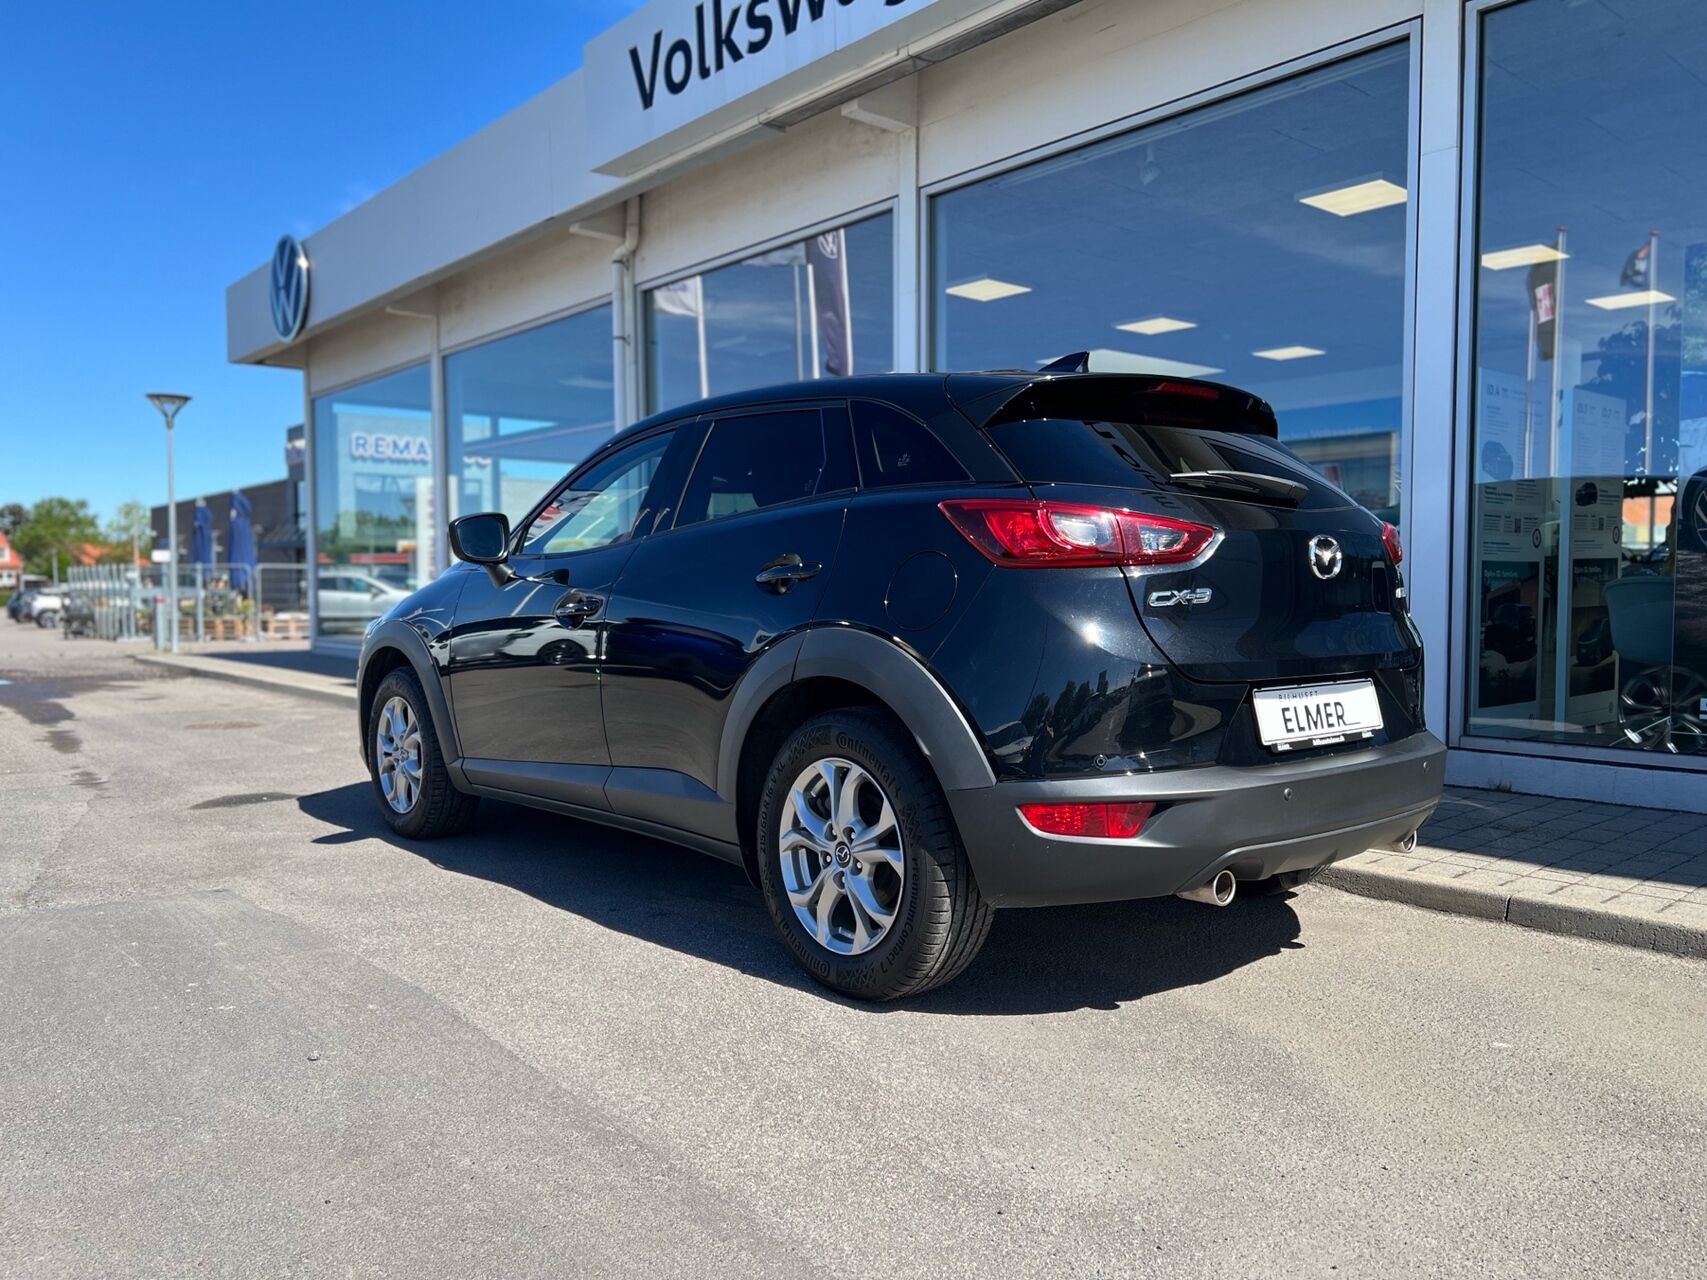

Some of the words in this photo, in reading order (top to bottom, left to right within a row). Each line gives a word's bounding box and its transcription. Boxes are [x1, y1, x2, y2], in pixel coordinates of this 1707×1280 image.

[629, 0, 907, 111] Volksw
[353, 434, 431, 458] REMA
[1147, 587, 1213, 607] CX-3
[1281, 701, 1360, 734] ELMER
